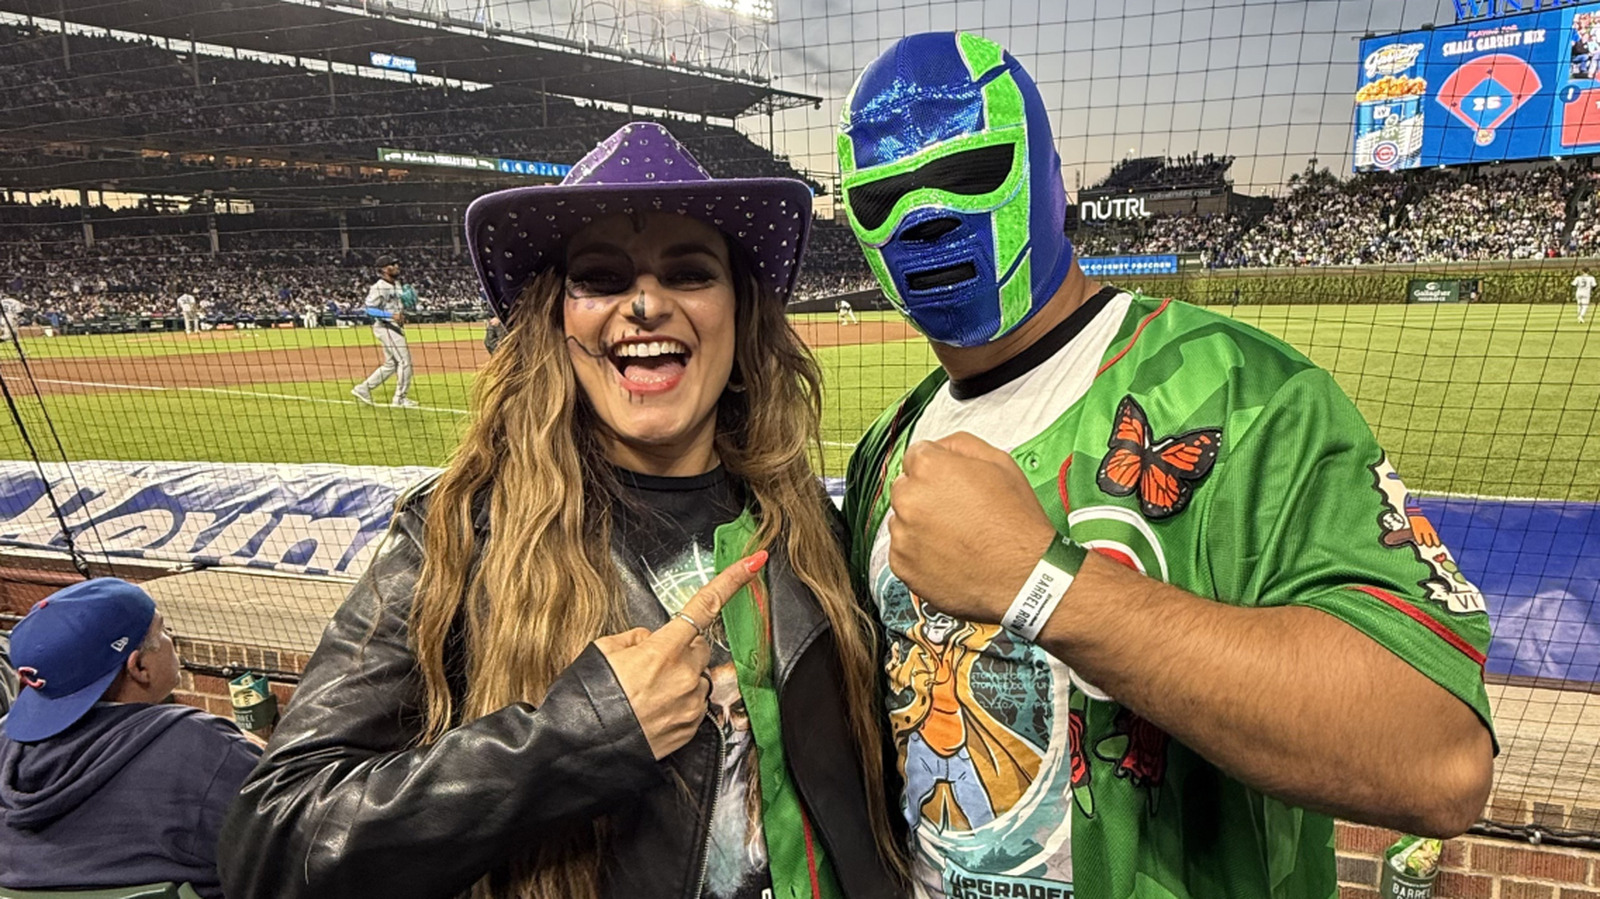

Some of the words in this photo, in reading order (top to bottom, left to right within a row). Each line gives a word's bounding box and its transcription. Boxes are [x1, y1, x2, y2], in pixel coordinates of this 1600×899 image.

[1442, 40, 1475, 57] SMALL
[1476, 32, 1522, 51] GARRETT
[1523, 29, 1546, 45] MIX
[1022, 573, 1054, 609] BARREL
